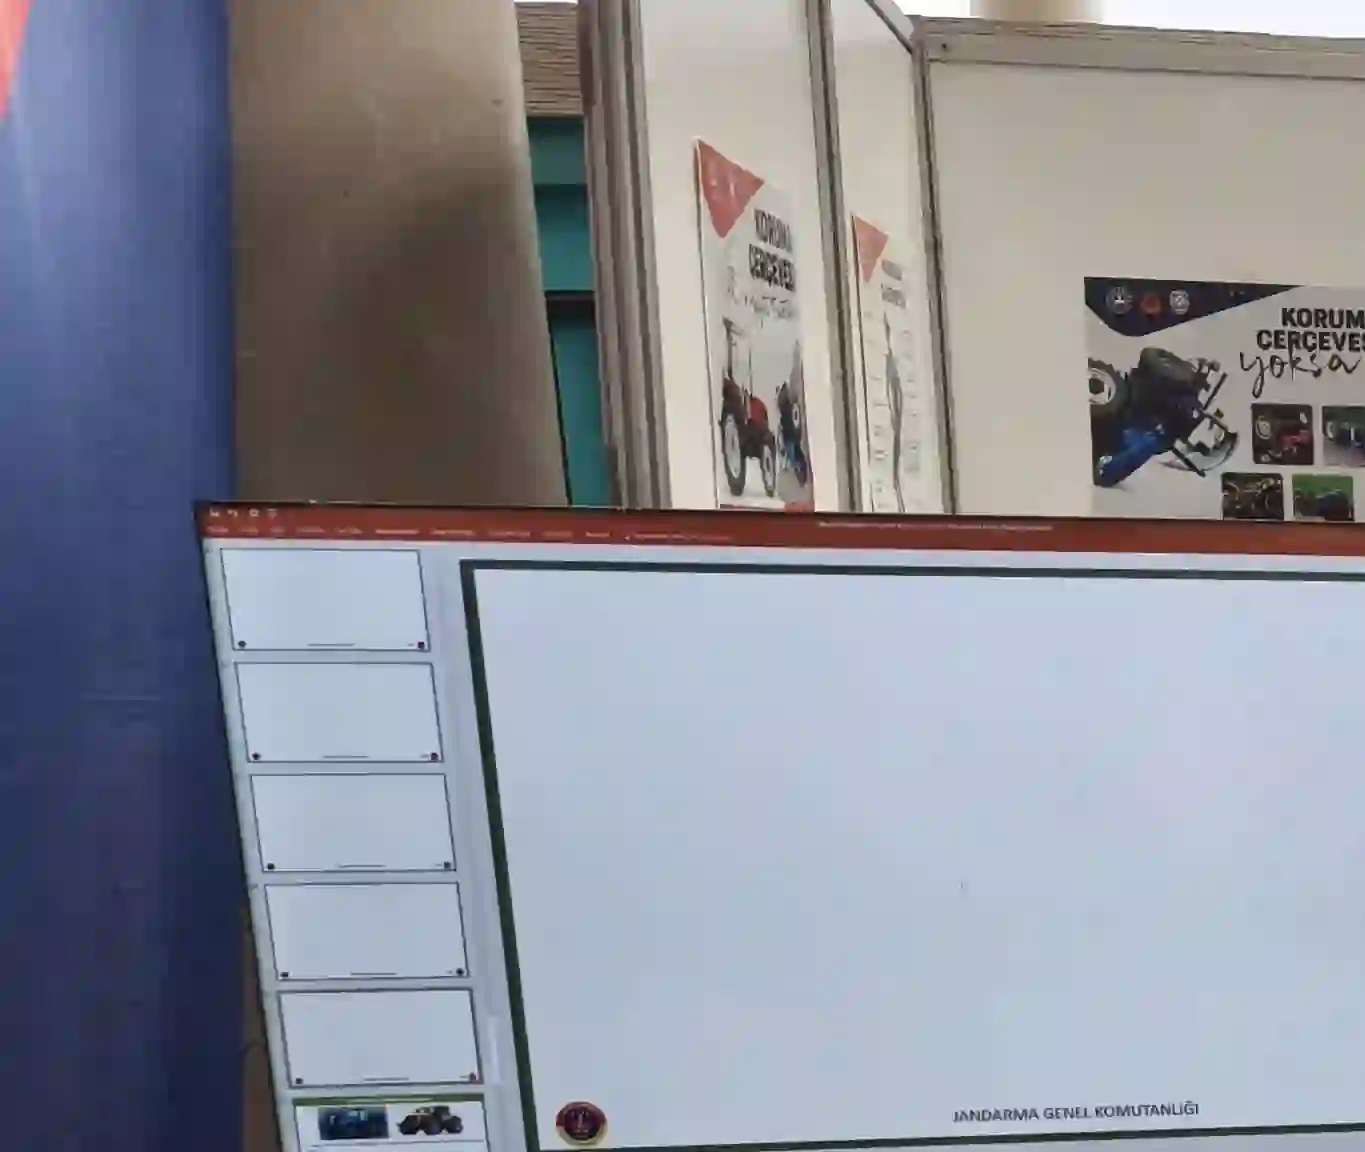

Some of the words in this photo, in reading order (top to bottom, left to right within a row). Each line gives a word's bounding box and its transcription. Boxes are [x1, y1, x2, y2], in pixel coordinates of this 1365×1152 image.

[1239, 348, 1362, 398] yoksa
[952, 1107, 1039, 1123] JANDARMA
[1043, 1106, 1092, 1120] GENEL
